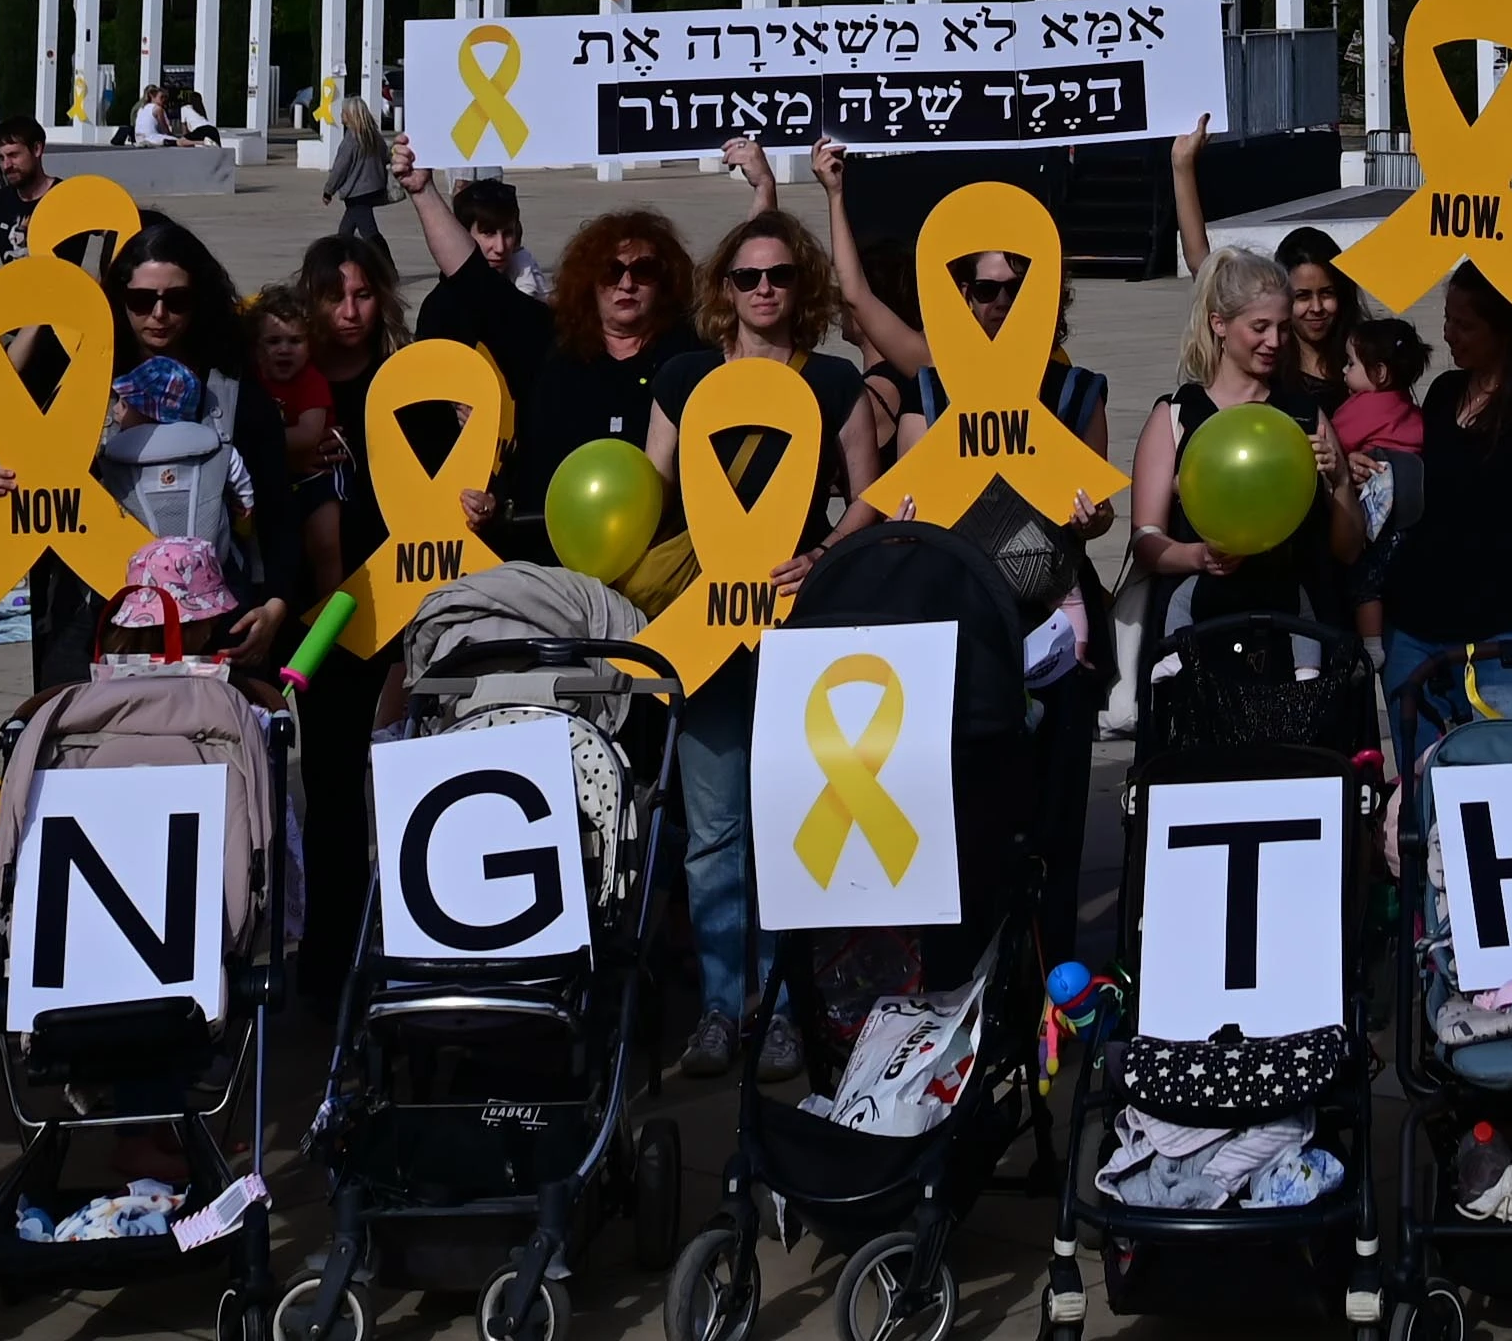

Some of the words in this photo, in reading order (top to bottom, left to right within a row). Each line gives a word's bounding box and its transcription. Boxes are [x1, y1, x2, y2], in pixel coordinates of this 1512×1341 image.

[1430, 193, 1504, 241] NOW.
[959, 409, 1036, 457] NOW.
[10, 488, 87, 534] NOW.
